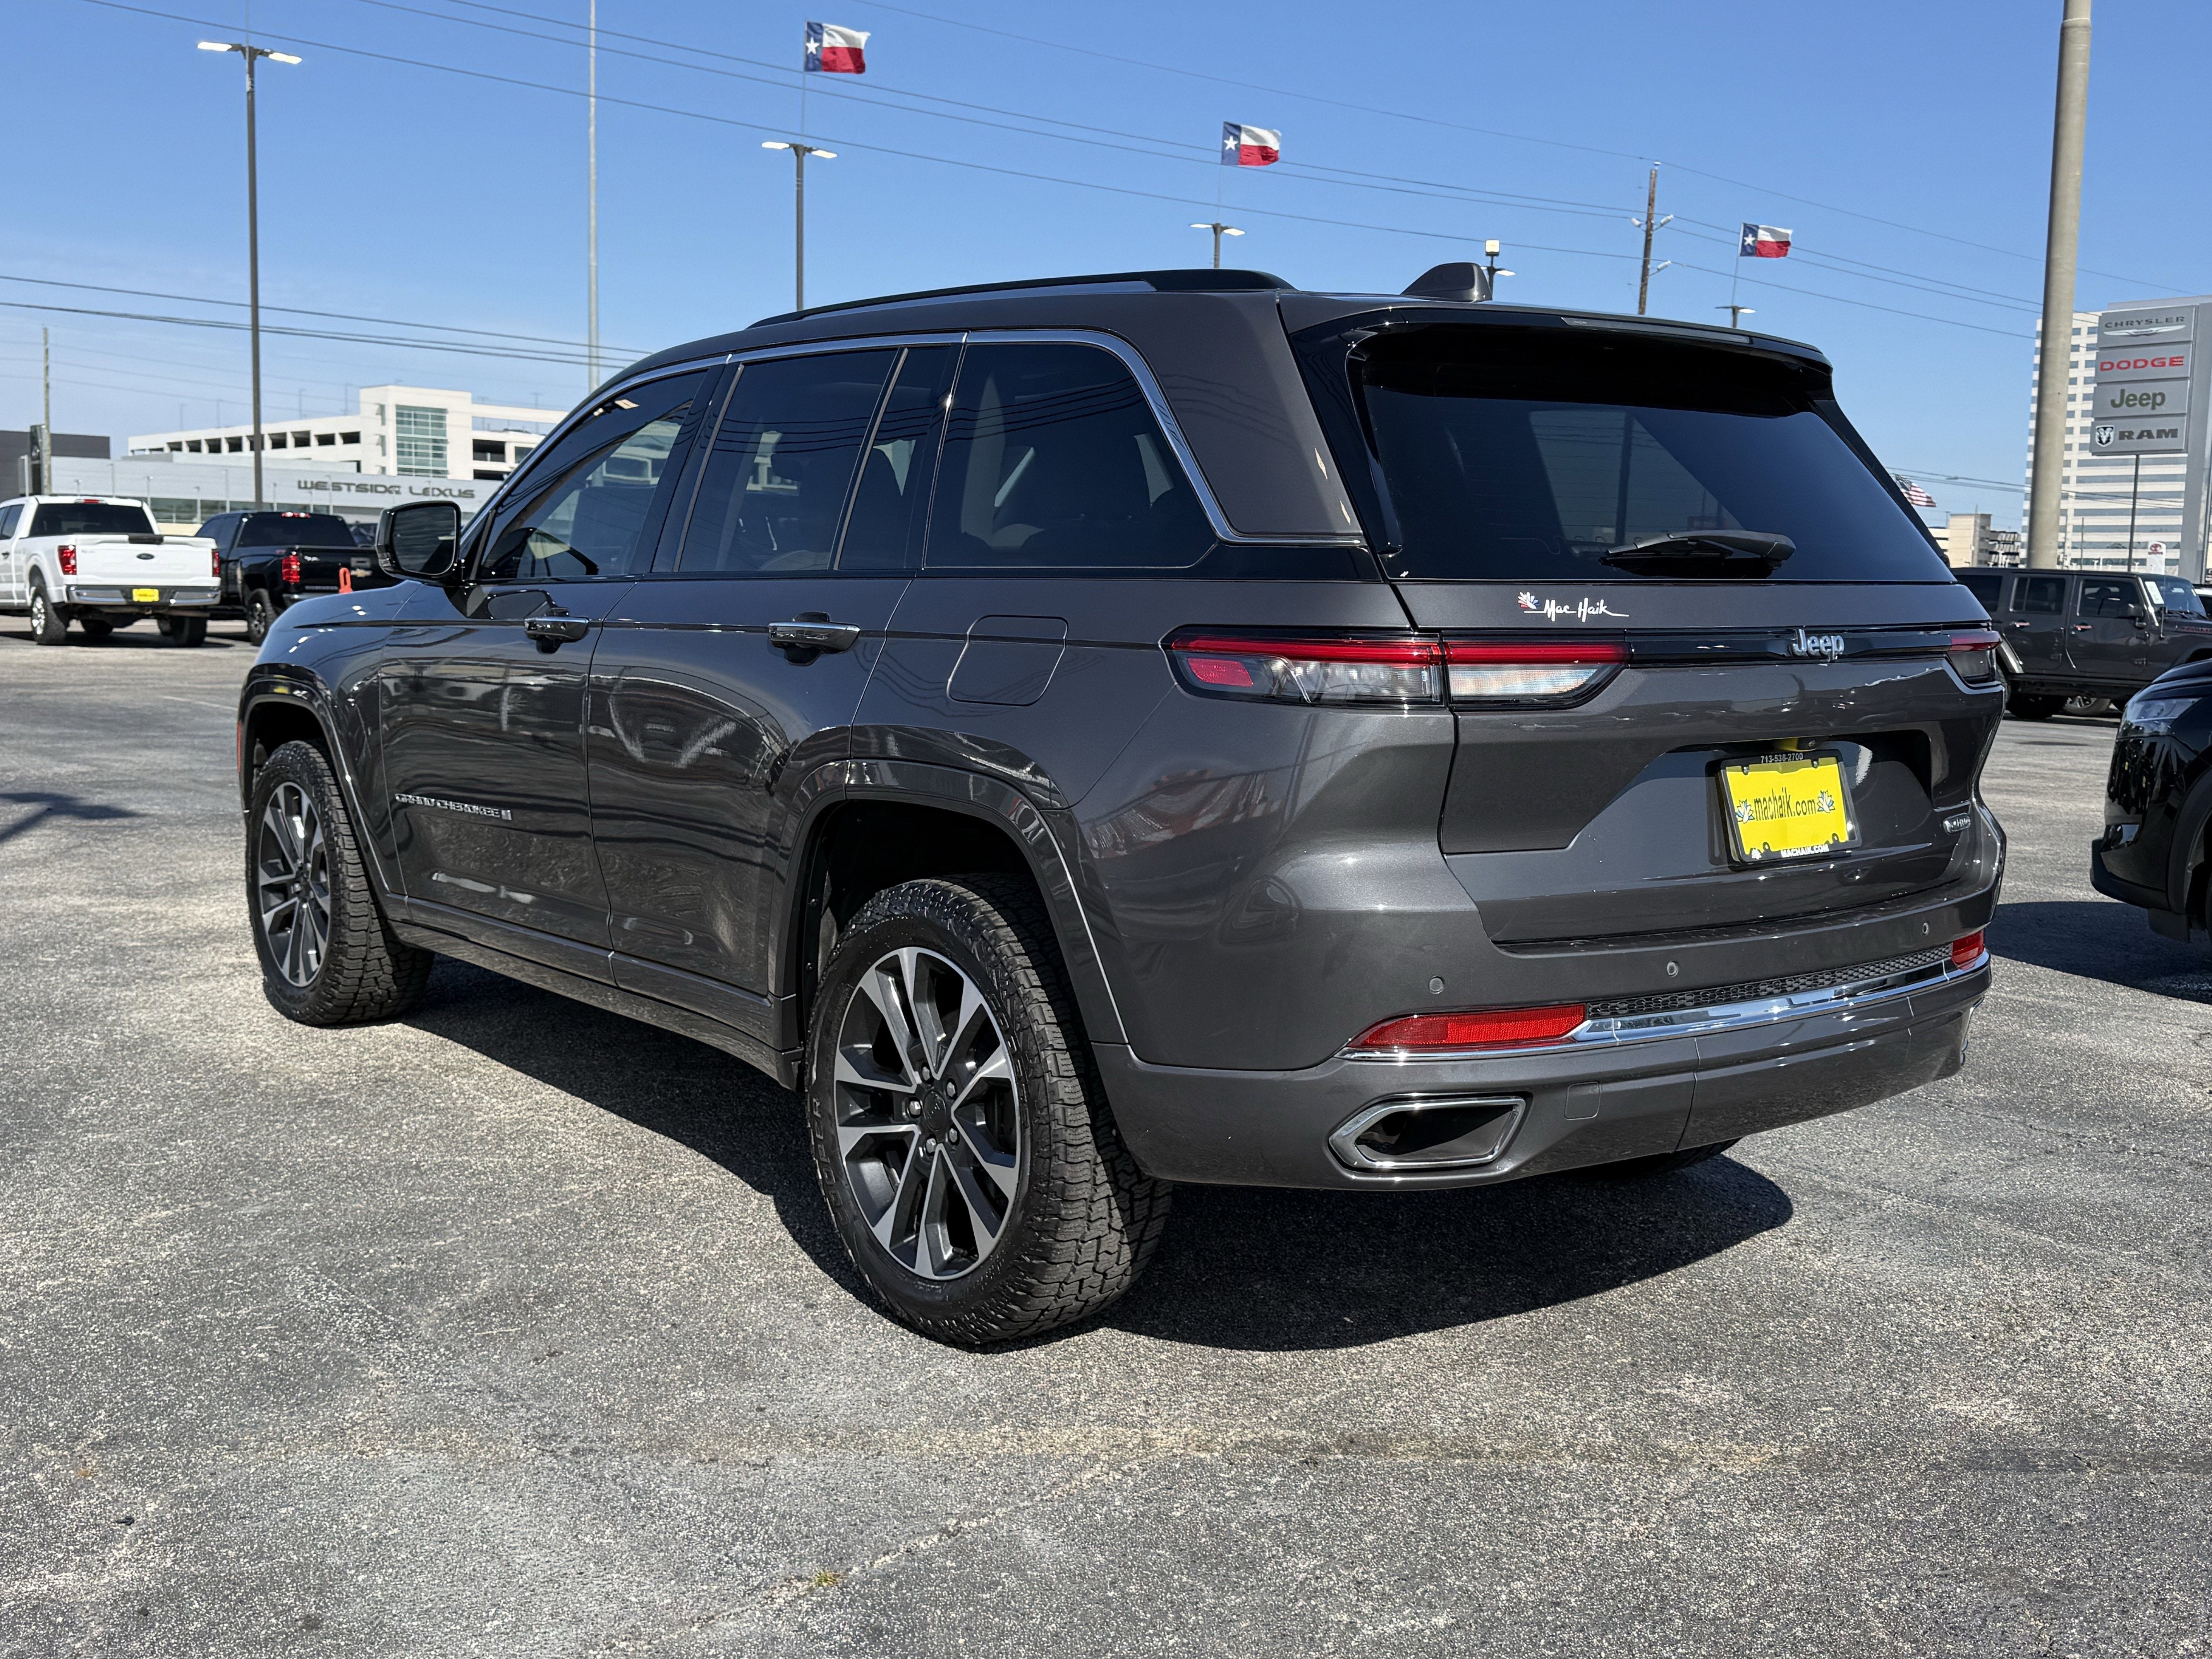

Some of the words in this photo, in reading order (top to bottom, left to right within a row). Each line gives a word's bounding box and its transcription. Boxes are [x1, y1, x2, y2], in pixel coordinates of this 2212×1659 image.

[2104, 316, 2185, 328] CHRYSLER
[2100, 356, 2185, 371] DODGE
[2110, 388, 2166, 410] Jeep
[2118, 428, 2178, 441] RAM
[409, 486, 476, 498] LEXUS
[1524, 598, 1577, 622] Mac
[1577, 597, 1629, 622] Haik
[1792, 629, 1844, 661] Jeep
[1760, 752, 1803, 763] 713-538-2700
[1753, 787, 1817, 821] machaik.com
[1780, 843, 1829, 858] MACHAIK.COM
